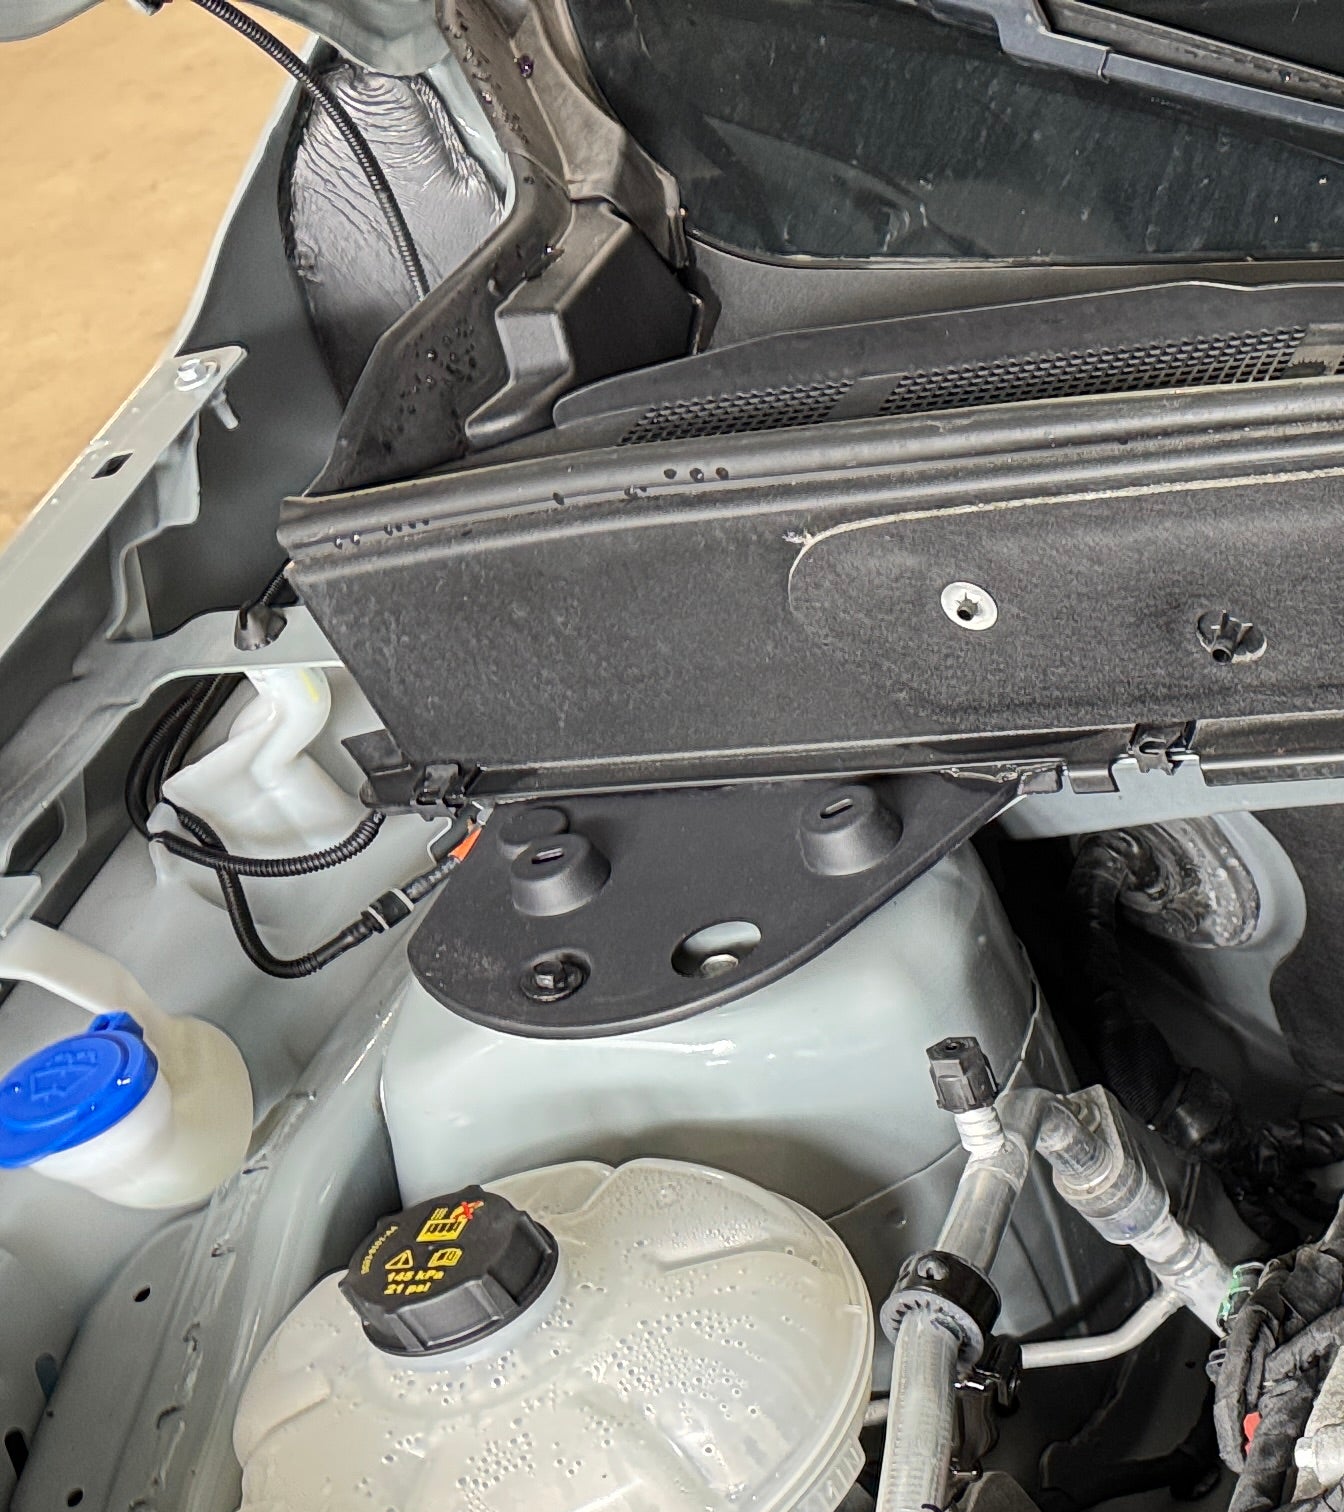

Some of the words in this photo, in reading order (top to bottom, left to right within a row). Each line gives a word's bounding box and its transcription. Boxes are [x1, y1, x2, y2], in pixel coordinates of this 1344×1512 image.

[414, 1269, 445, 1281] kPa
[383, 1283, 405, 1295] 21
[404, 1281, 432, 1296] psi
